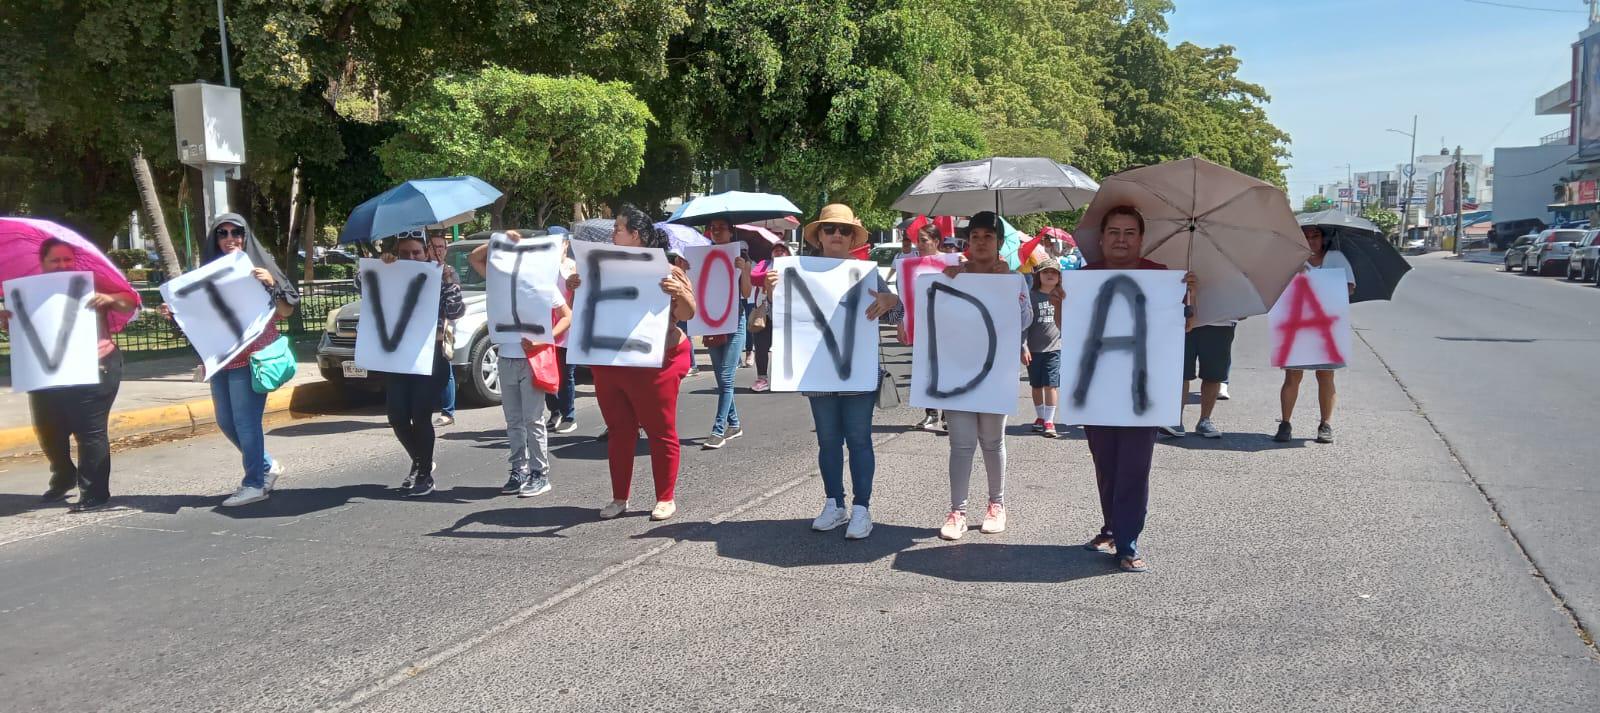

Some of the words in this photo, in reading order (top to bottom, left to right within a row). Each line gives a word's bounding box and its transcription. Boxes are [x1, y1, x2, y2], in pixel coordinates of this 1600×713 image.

[12, 276, 87, 371] V
[365, 269, 427, 352] V
[491, 240, 552, 334] I
[583, 249, 653, 354] E
[698, 249, 734, 328] O
[785, 267, 862, 380] N
[1274, 273, 1345, 366] A
[926, 281, 997, 398] D
[1073, 274, 1151, 415] A
